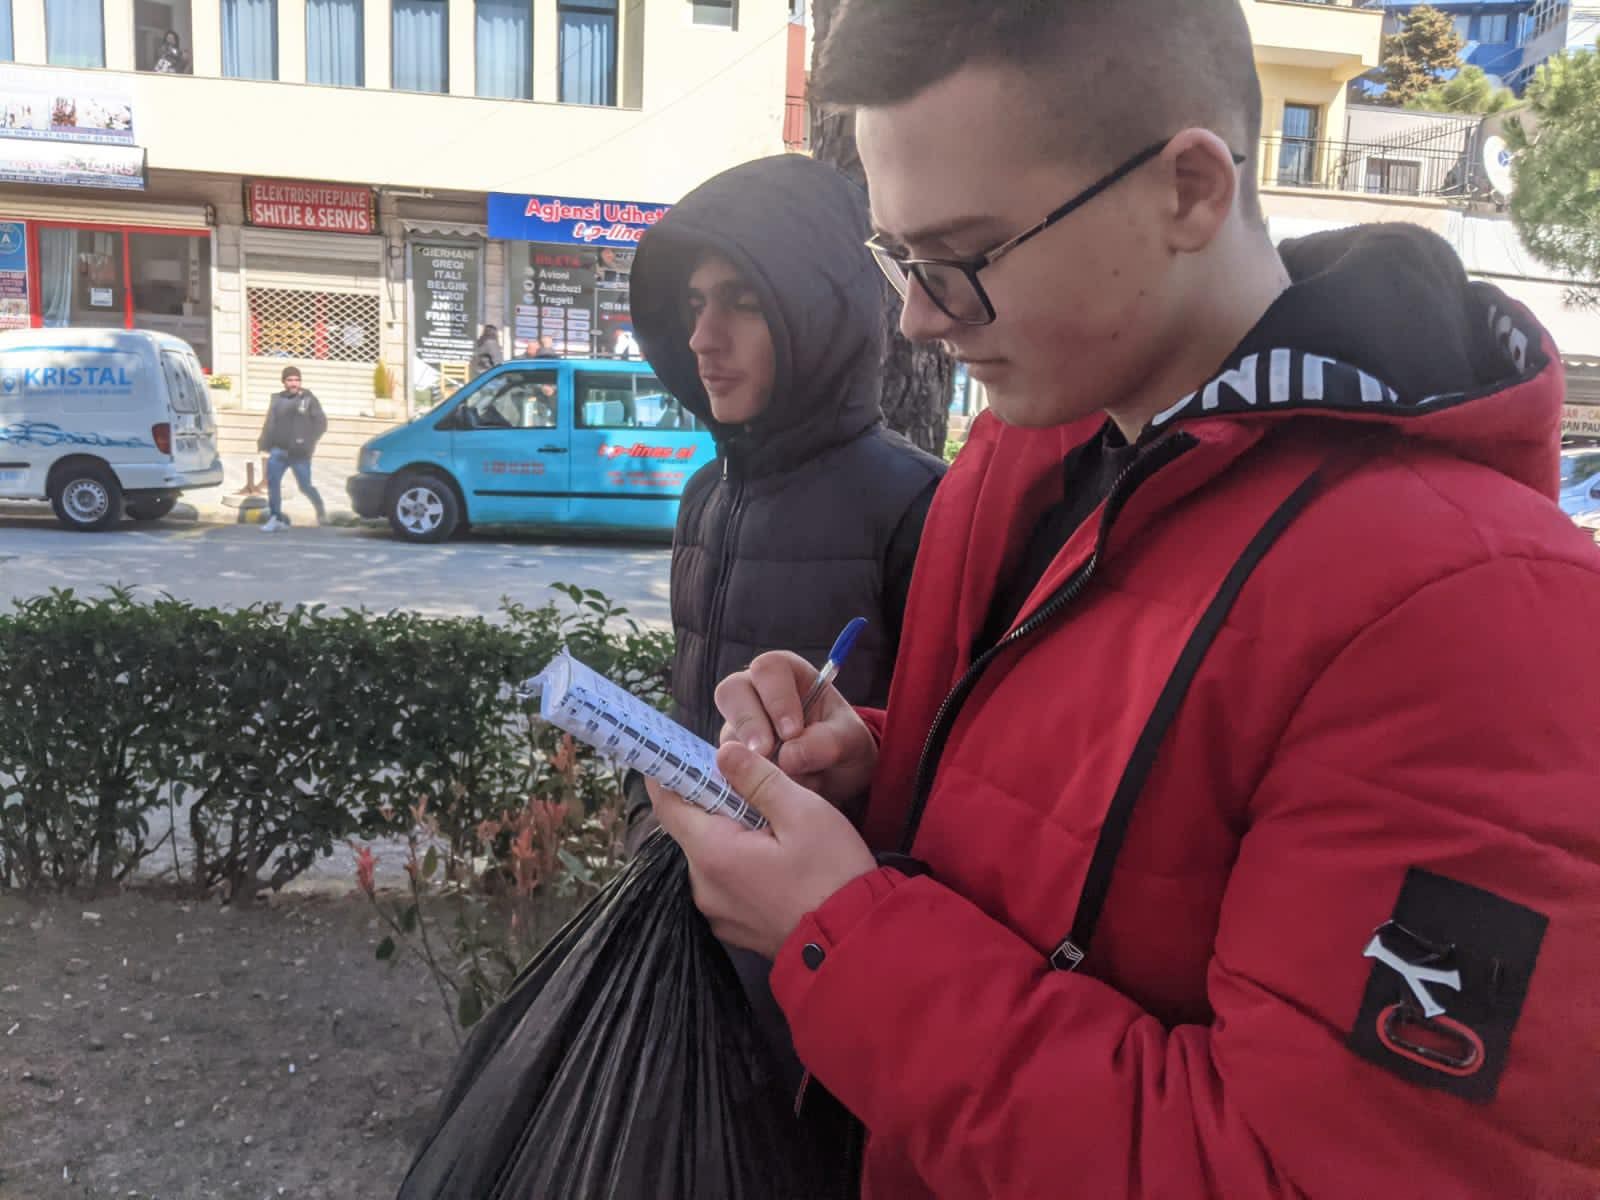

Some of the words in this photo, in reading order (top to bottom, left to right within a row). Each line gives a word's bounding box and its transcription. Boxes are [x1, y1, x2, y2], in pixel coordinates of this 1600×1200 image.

[254, 185, 367, 208] ELEKTROSHTEPIAKE
[255, 203, 302, 225] SHITJE
[305, 206, 316, 226] &
[318, 207, 367, 230] SERVIS
[524, 198, 600, 222] Agjensi
[603, 203, 671, 225] Udhet
[434, 270, 462, 280] ITALI
[431, 301, 464, 312] ANGLI
[425, 311, 469, 323] FRANCE
[24, 367, 133, 385] KRISTAL
